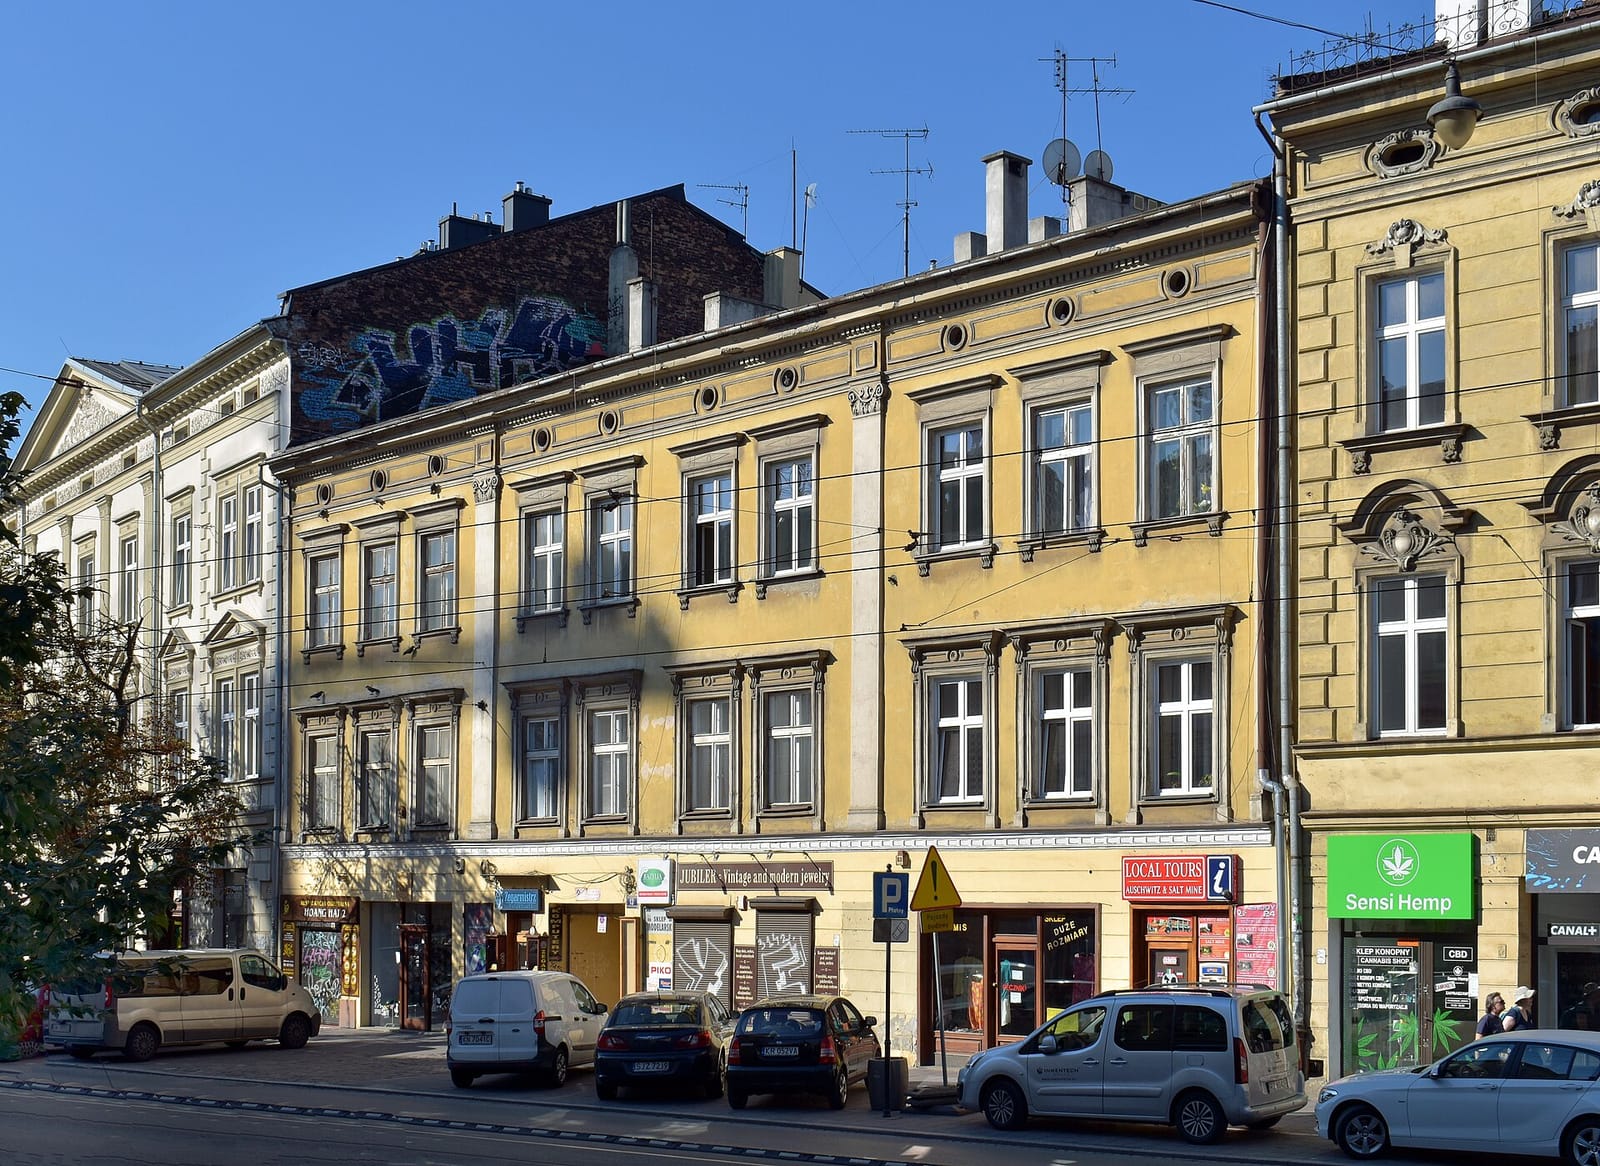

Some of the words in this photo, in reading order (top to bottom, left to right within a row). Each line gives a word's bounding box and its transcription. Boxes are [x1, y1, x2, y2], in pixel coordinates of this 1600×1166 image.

[1125, 862, 1162, 878] LOCAL
[1164, 862, 1202, 878] TOURS
[680, 869, 717, 884] JUBILER
[723, 869, 751, 887] Vintage
[753, 869, 767, 884] and
[769, 869, 799, 884] modern
[800, 869, 830, 887] jewelry
[882, 877, 902, 913] P
[1126, 886, 1161, 895] AUSCHWITZ
[1163, 886, 1167, 895] &
[1169, 886, 1184, 894] SALT
[1186, 886, 1202, 895] MINE
[1346, 893, 1394, 911] Sensi
[1398, 893, 1452, 915] Hemp
[304, 907, 326, 917] HOANG
[952, 923, 968, 932] MIS
[1550, 925, 1597, 936] CANAL+
[1047, 926, 1089, 951] ROZMIARY
[1448, 950, 1468, 958] CBD
[650, 966, 672, 975] PIKO
